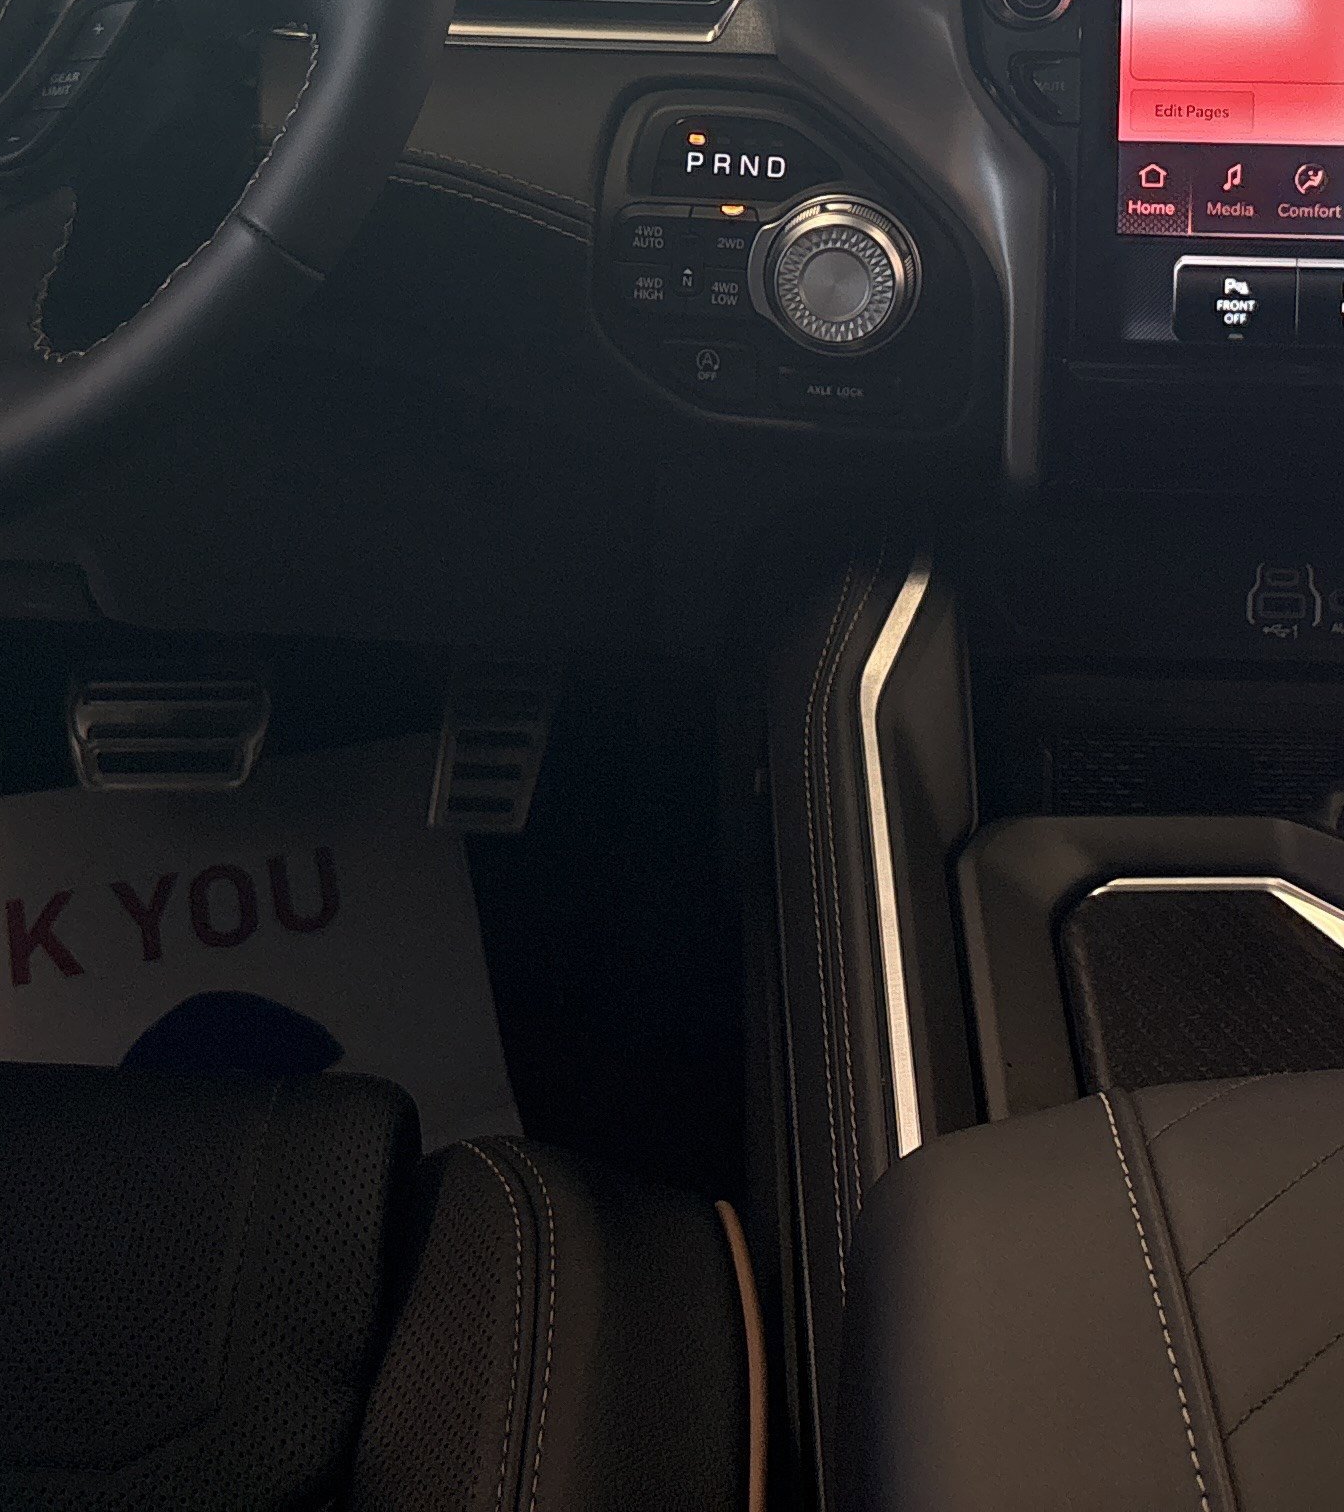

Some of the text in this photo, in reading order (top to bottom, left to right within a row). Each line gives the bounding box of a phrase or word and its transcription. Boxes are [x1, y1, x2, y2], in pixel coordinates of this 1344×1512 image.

[1155, 102, 1229, 122] Edit Pages
[1128, 200, 1175, 216] Home
[1206, 201, 1254, 218] Media
[1277, 202, 1342, 220] Comfort
[634, 226, 663, 238] 4WD
[632, 237, 664, 249] AUTO
[716, 238, 744, 250] 2WD
[635, 277, 663, 289] 4WD
[711, 282, 739, 294] 4WD
[633, 288, 664, 300] HIGH
[711, 293, 738, 306] LOW
[1216, 299, 1254, 312] FRONT
[1223, 313, 1247, 326] OFF
[836, 386, 864, 397] LOCK
[109, 846, 341, 962] YOU
